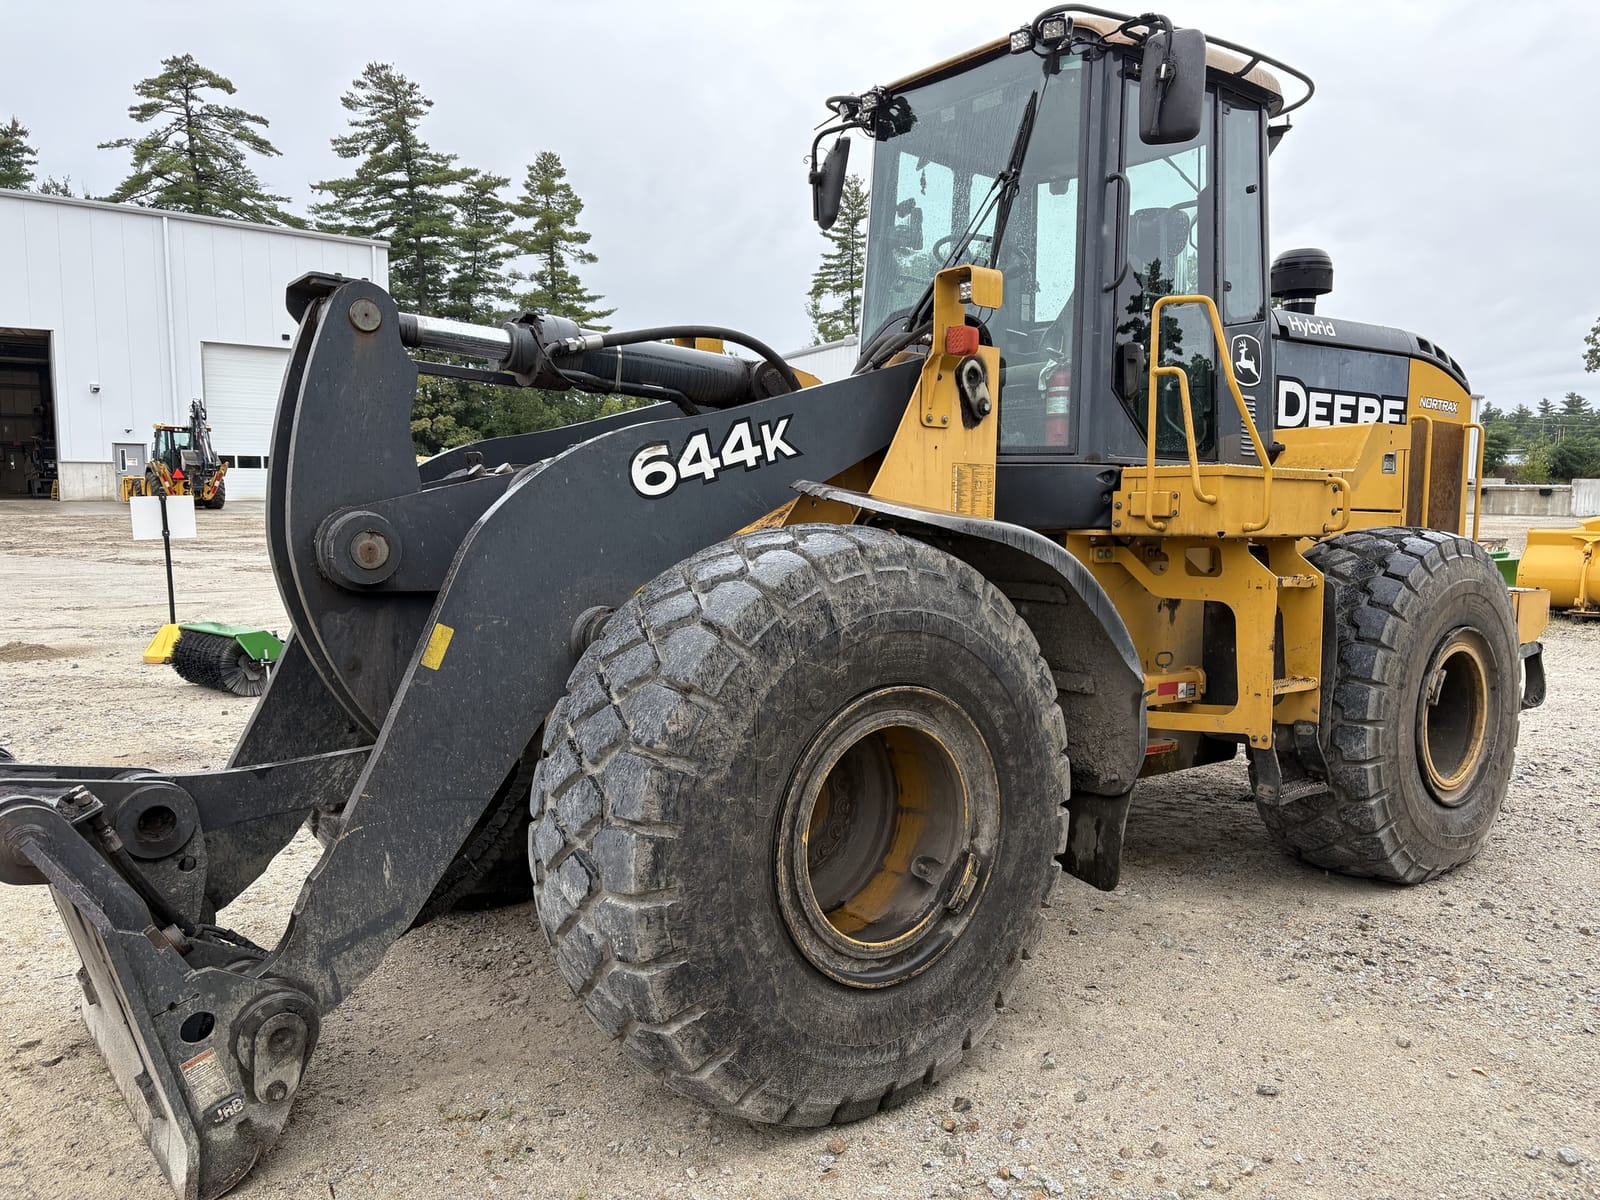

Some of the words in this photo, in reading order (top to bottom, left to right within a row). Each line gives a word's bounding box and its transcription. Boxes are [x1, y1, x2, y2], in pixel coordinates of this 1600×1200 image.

[1287, 316, 1337, 337] Hybrid
[1419, 396, 1459, 413] NORTRAX
[630, 416, 799, 497] 644K
[214, 1098, 244, 1123] JRB
